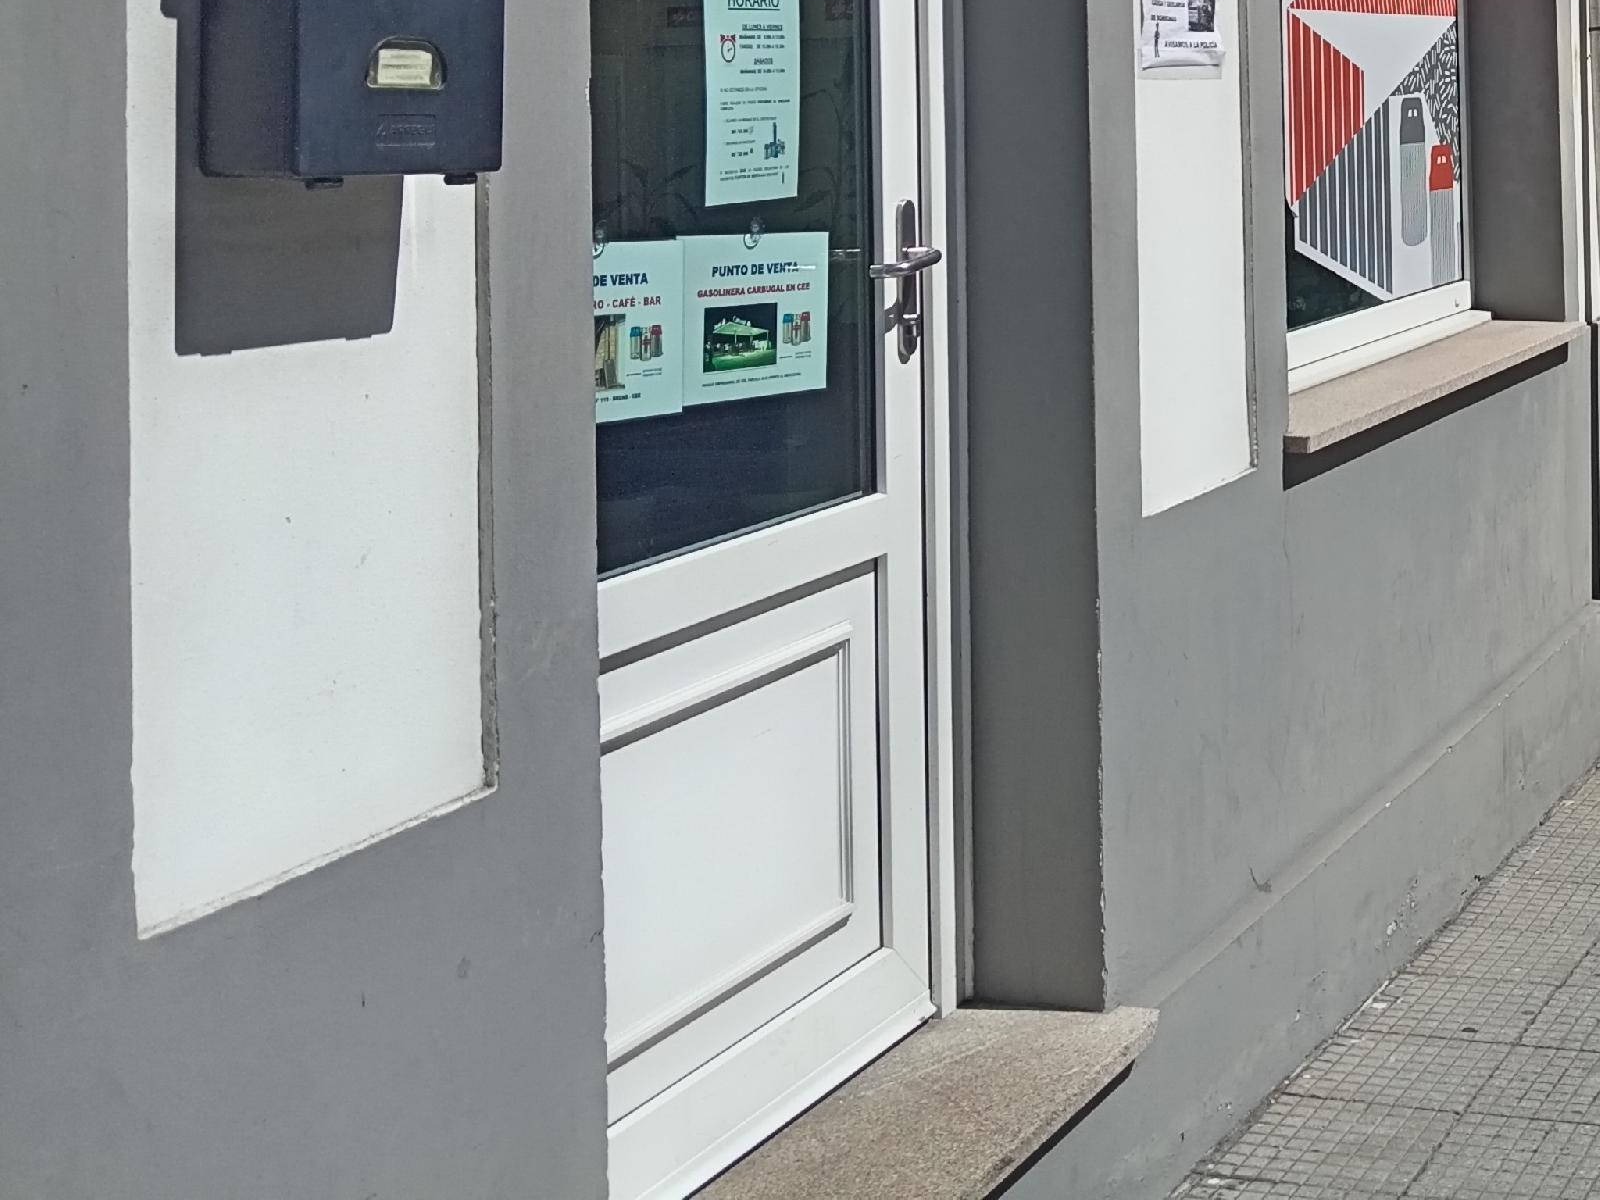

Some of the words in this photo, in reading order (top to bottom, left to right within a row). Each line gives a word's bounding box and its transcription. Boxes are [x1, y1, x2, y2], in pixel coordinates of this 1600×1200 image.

[711, 263, 748, 278] PUNTO
[750, 264, 765, 276] DE
[766, 261, 800, 274] VENTA
[592, 274, 608, 287] DE
[610, 272, 649, 286] VENTA
[697, 286, 746, 299] GASOLINERA
[612, 296, 636, 308] CAFÉ
[643, 296, 661, 306] BAR
